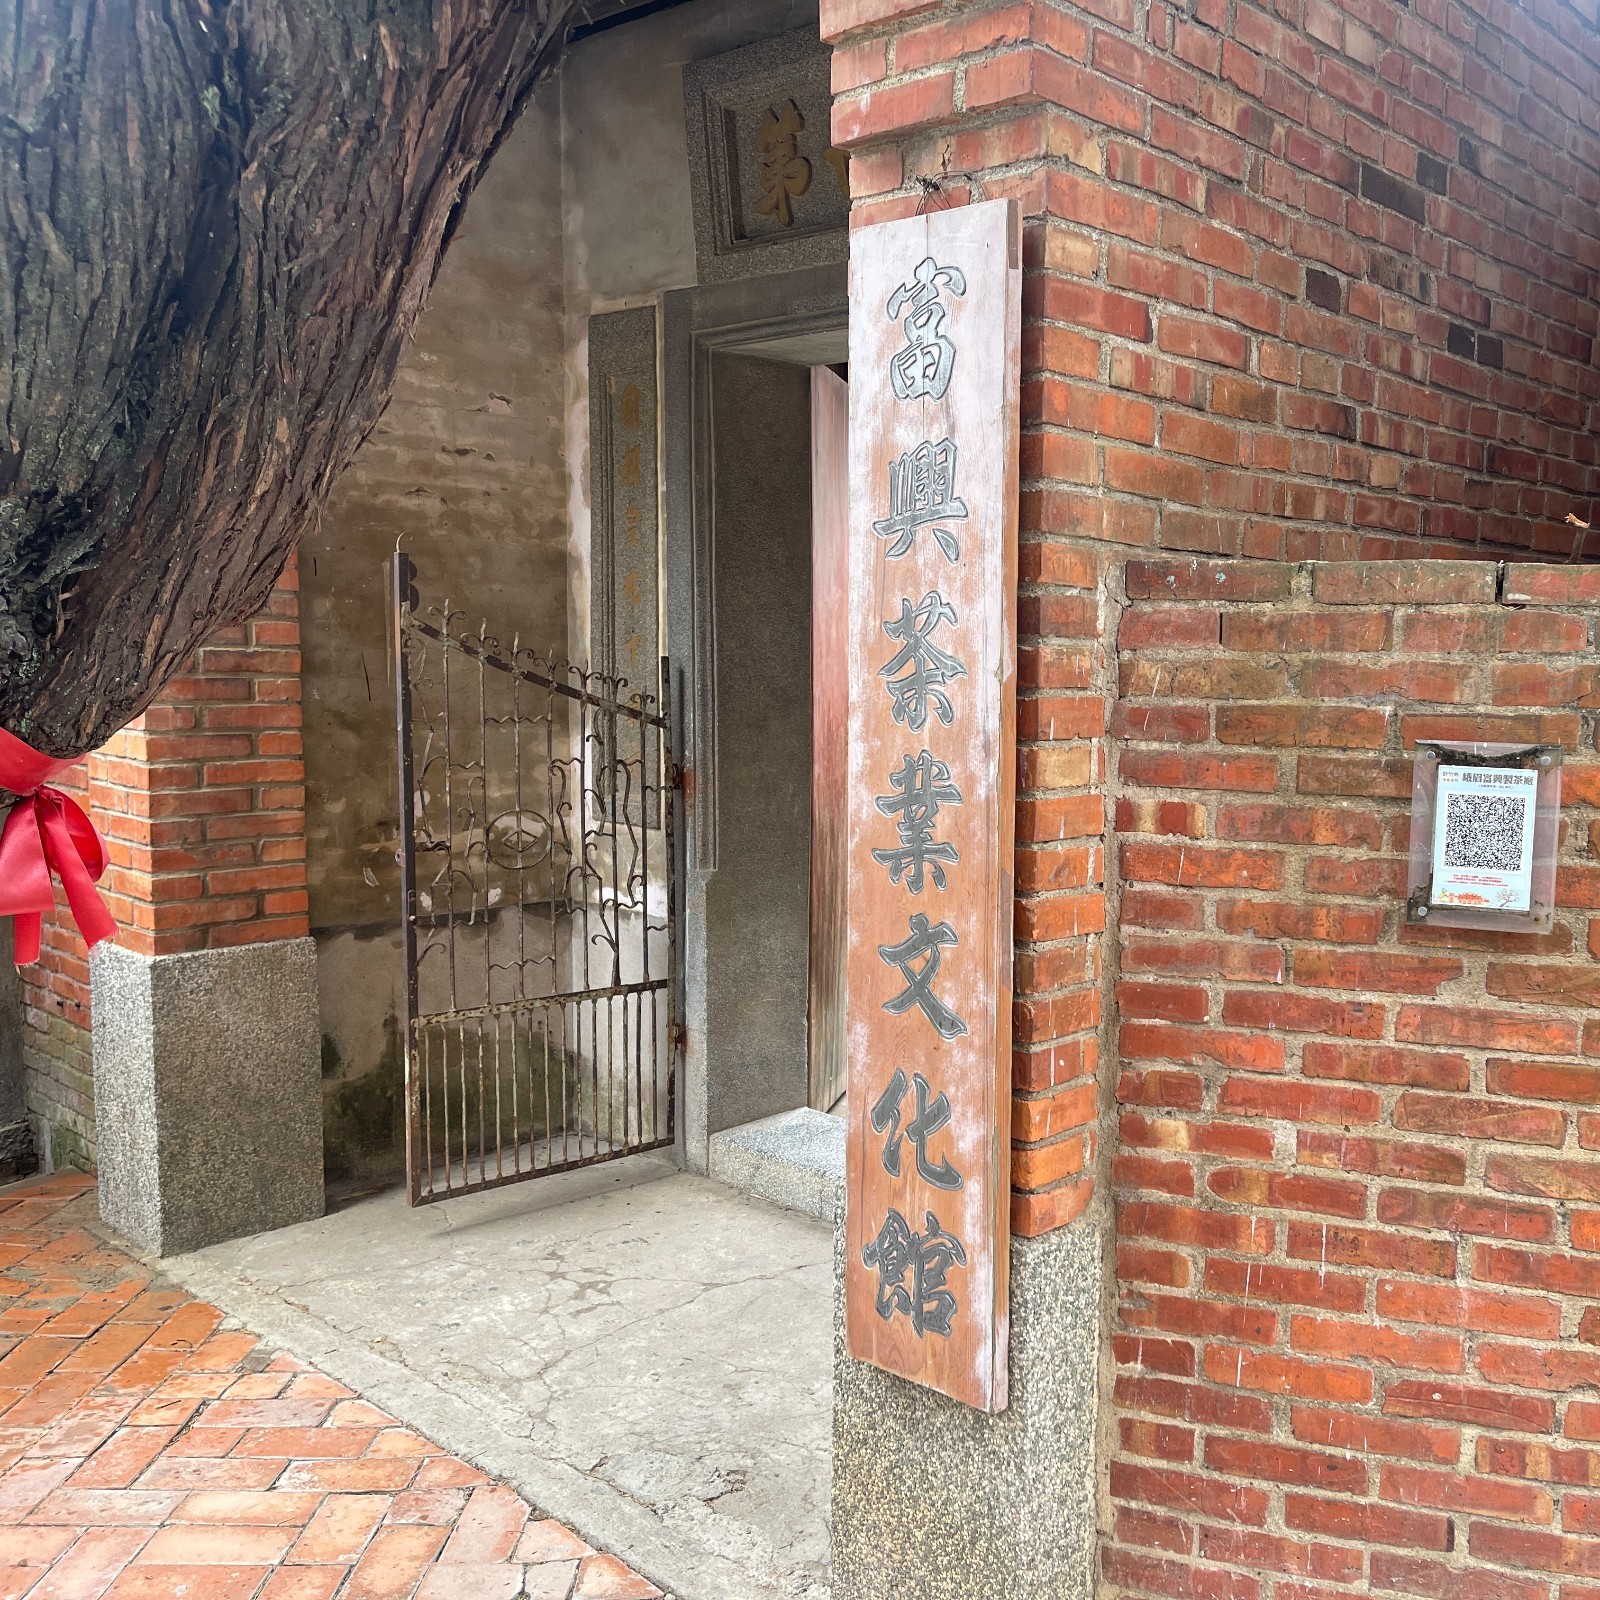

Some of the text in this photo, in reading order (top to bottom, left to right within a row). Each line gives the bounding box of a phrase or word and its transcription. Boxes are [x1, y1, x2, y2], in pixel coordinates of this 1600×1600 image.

[862, 257, 968, 1338] 富興茶業文化館
